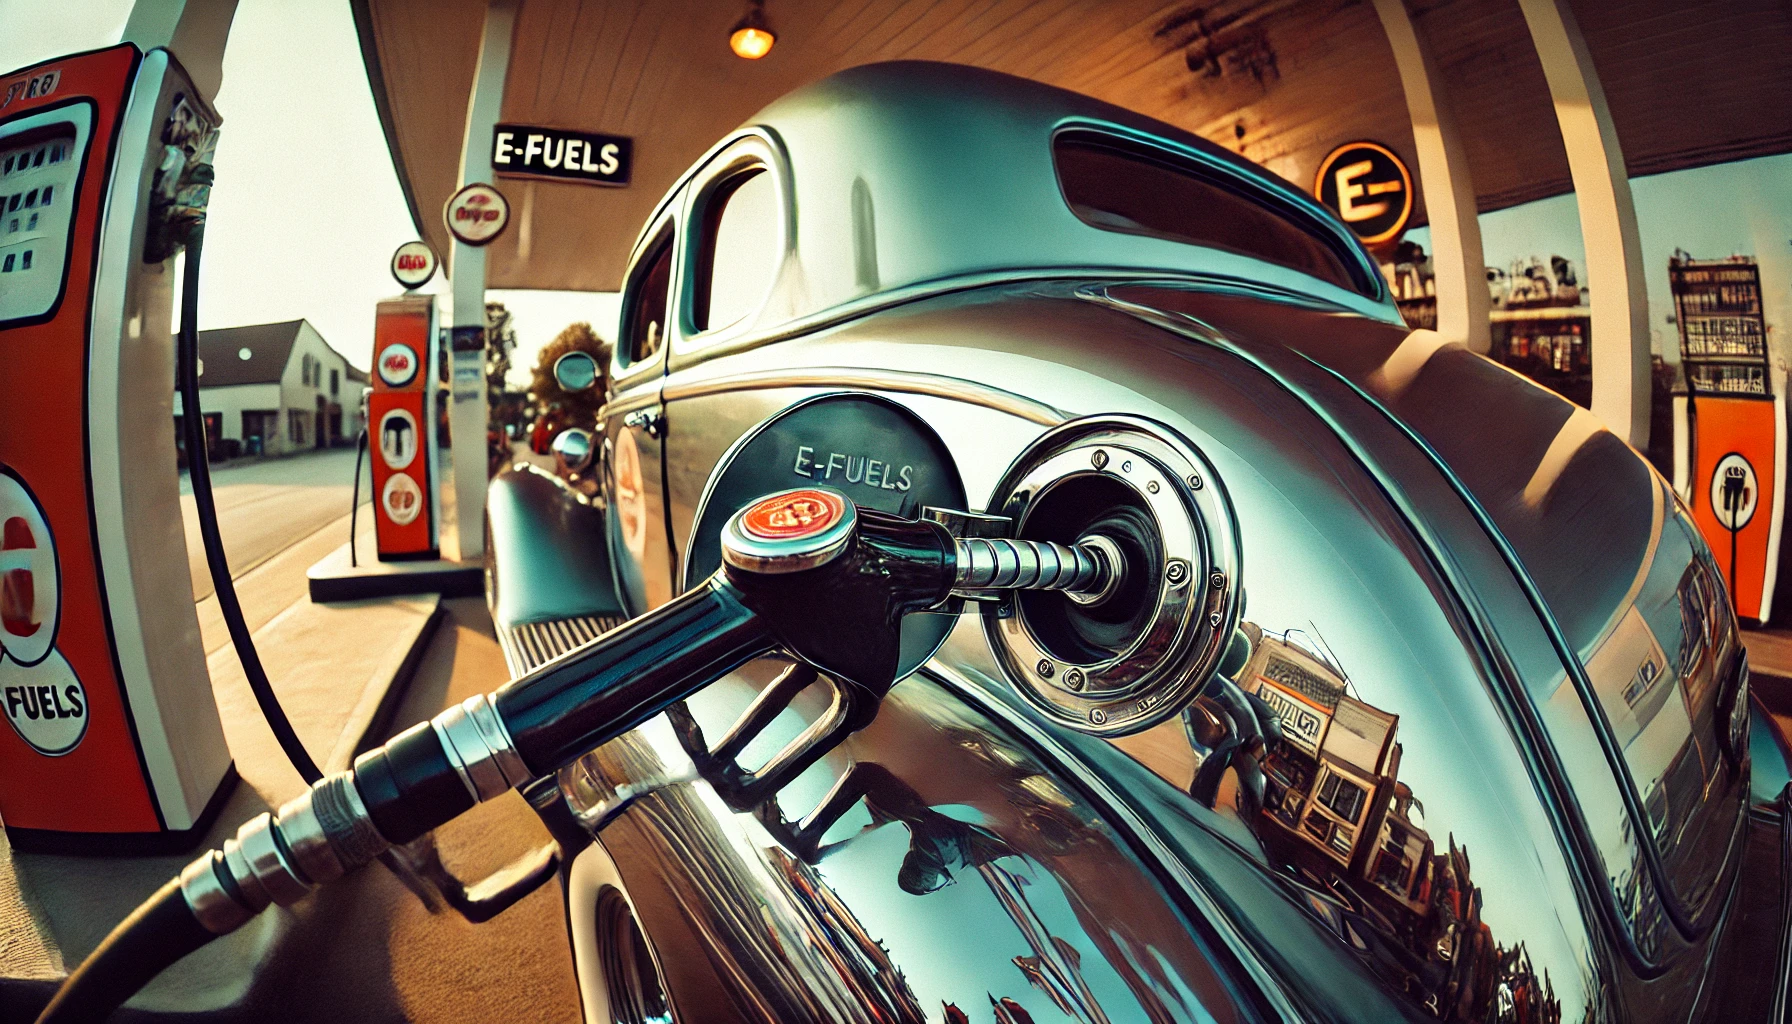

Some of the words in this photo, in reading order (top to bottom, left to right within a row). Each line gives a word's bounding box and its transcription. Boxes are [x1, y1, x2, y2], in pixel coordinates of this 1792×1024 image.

[494, 132, 619, 175] E-FUELS
[794, 446, 913, 491] E-FUELS
[5, 685, 83, 719] FUELS
